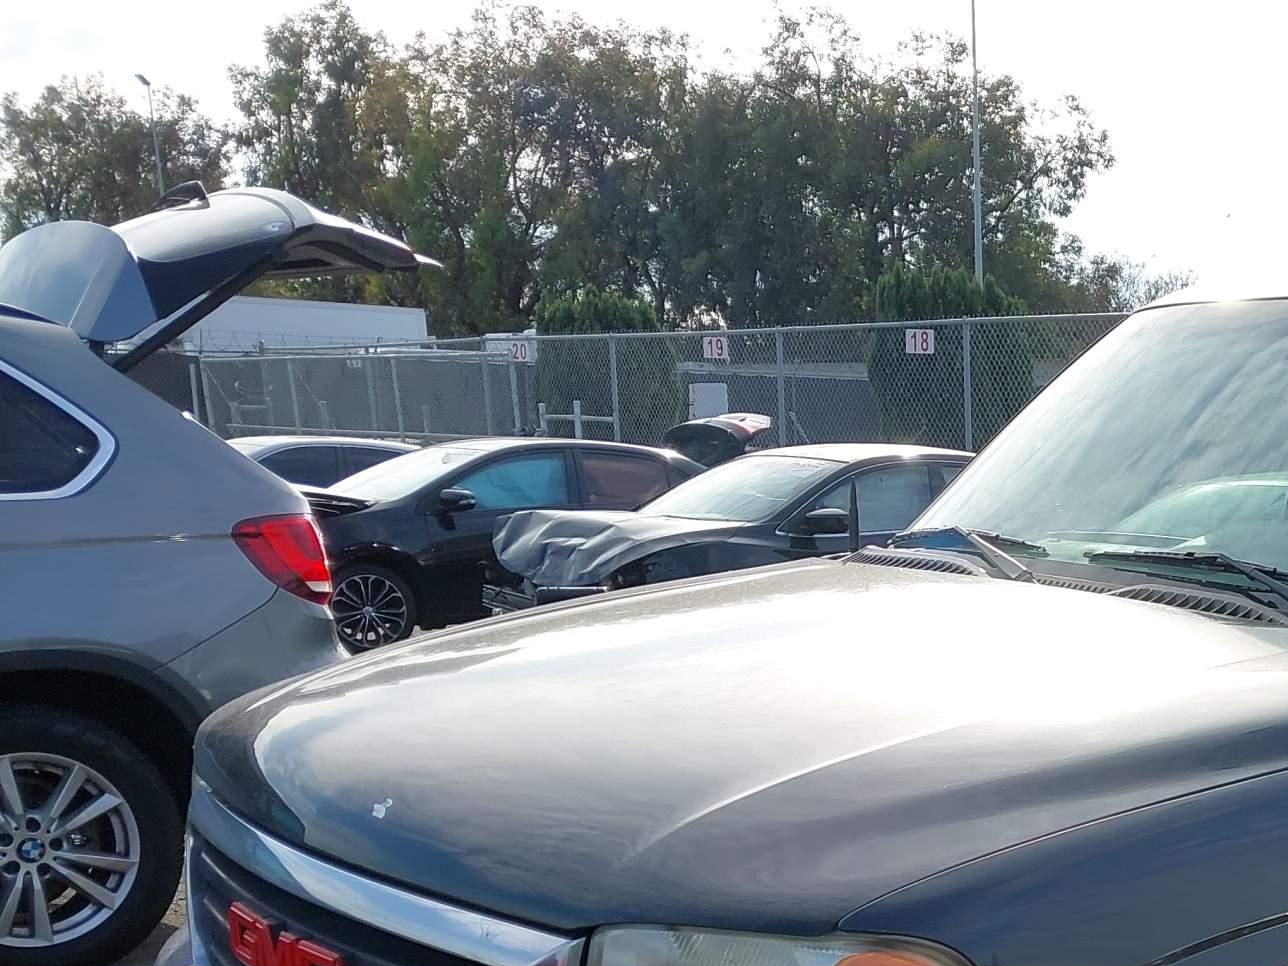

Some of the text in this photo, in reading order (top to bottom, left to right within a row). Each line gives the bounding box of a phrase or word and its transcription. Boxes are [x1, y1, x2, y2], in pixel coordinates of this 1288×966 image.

[512, 342, 527, 360] 20
[707, 338, 724, 357] 19
[911, 331, 929, 352] 18
